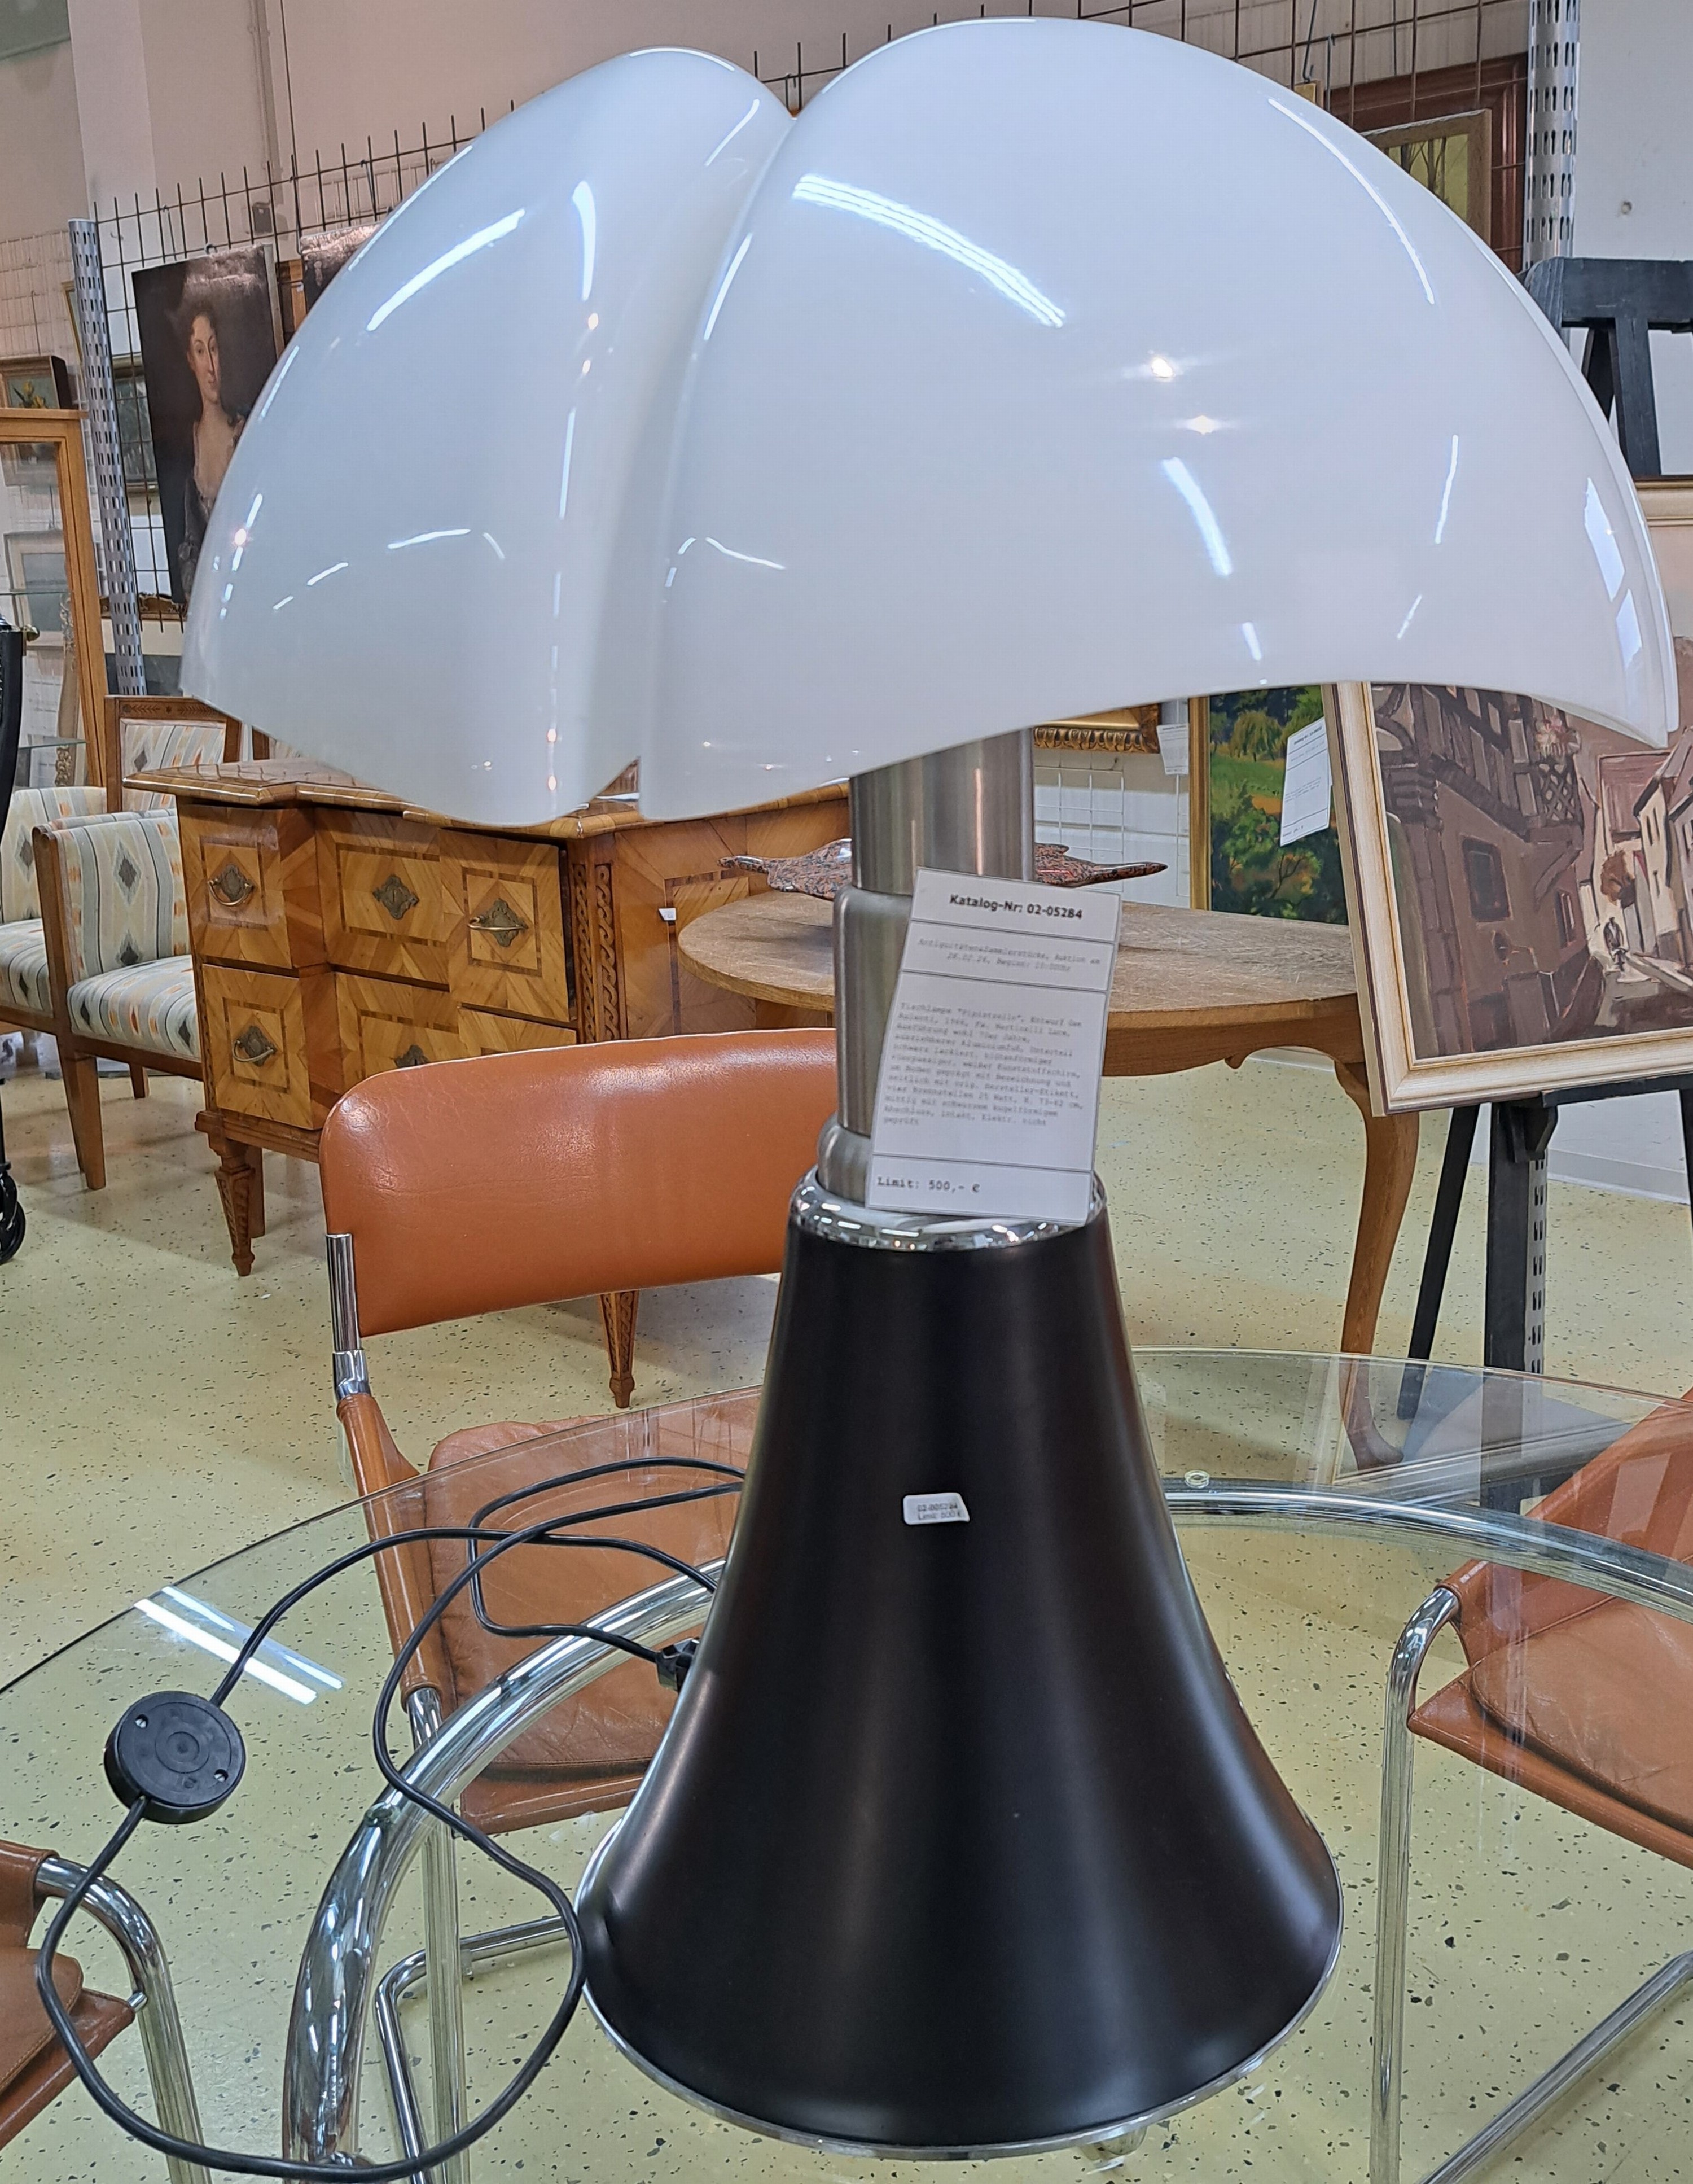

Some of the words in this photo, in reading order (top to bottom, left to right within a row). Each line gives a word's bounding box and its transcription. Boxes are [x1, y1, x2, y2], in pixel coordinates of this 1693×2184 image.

[949, 894, 1023, 914] Katalog-Nr:
[1027, 904, 1082, 920] 02-05284
[877, 1175, 919, 1189] Limit:
[928, 1179, 964, 1195] 500,-
